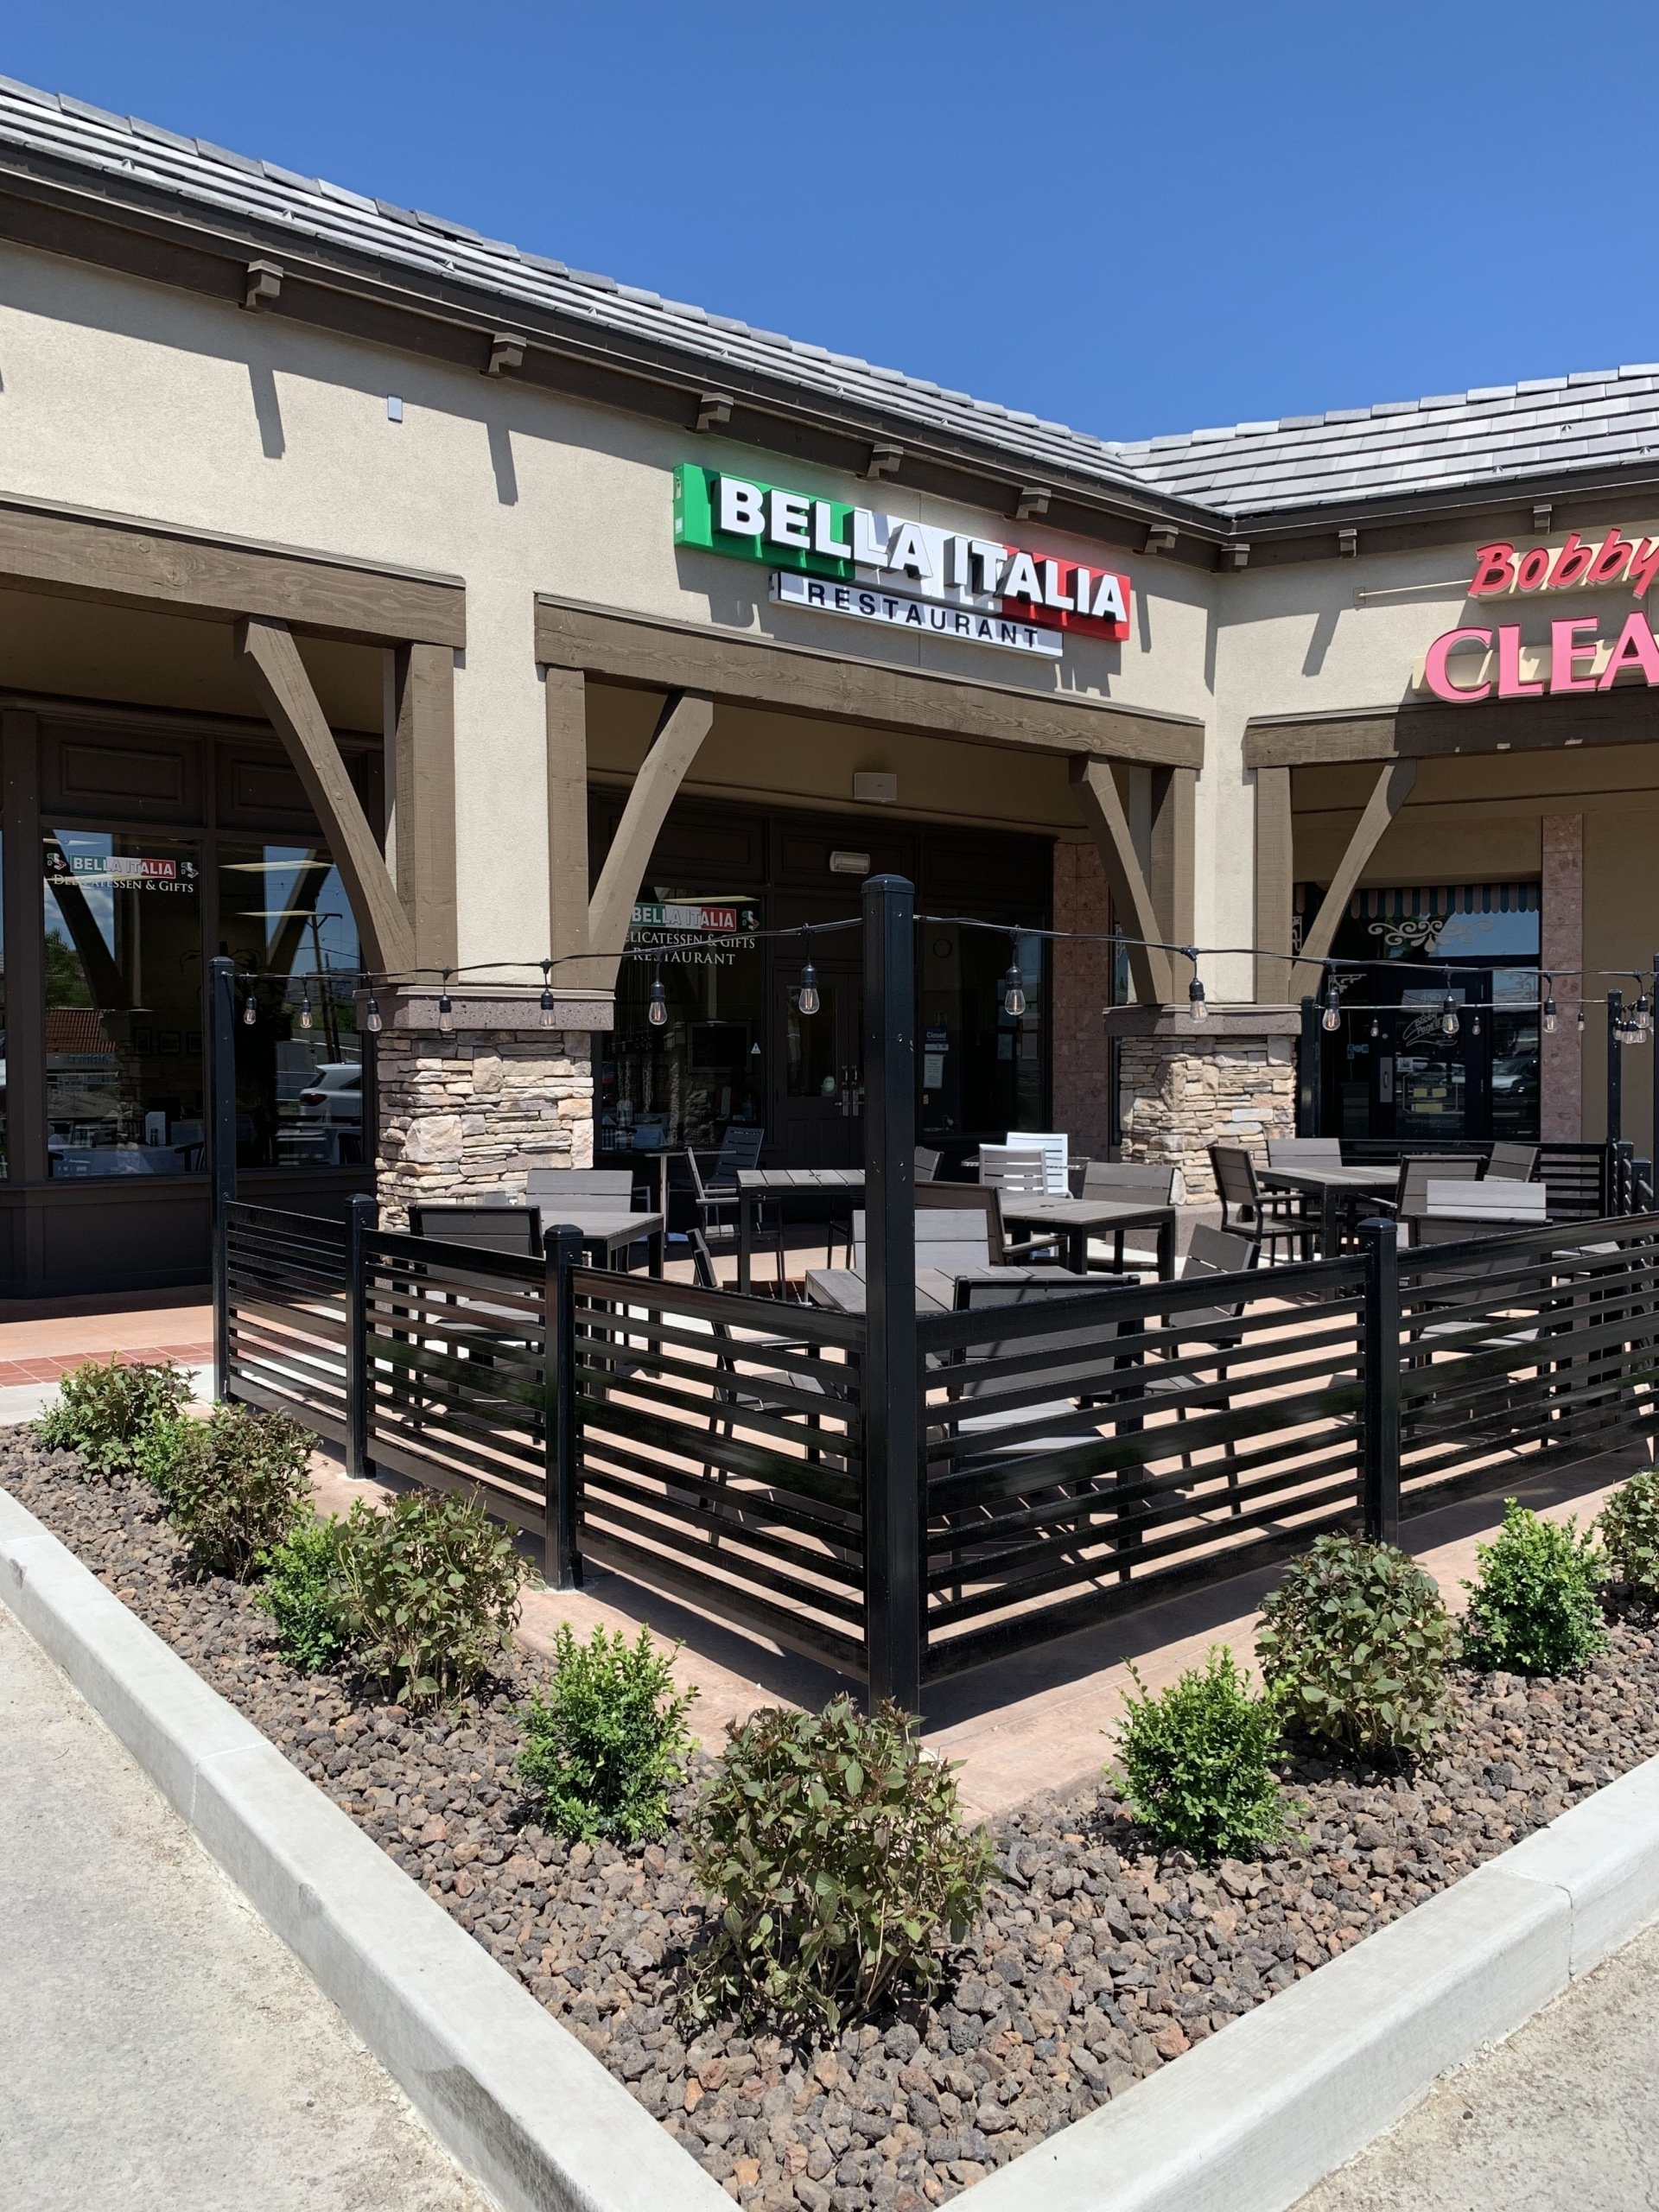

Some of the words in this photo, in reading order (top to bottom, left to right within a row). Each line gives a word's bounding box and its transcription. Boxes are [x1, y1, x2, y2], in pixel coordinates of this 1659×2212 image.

[717, 475, 933, 578] BELLA
[950, 536, 1128, 622] ITALIA
[1467, 527, 1659, 600] Bobby
[807, 582, 1039, 649] RESTAURANT
[1425, 609, 1659, 704] CLEA
[73, 857, 122, 873] BELLA
[126, 860, 173, 875] ITALIA
[145, 880, 156, 891] &
[625, 931, 702, 945] ELICATESSEN
[707, 933, 717, 947] &
[632, 906, 682, 925] BELLA
[686, 910, 734, 928] ITALIA
